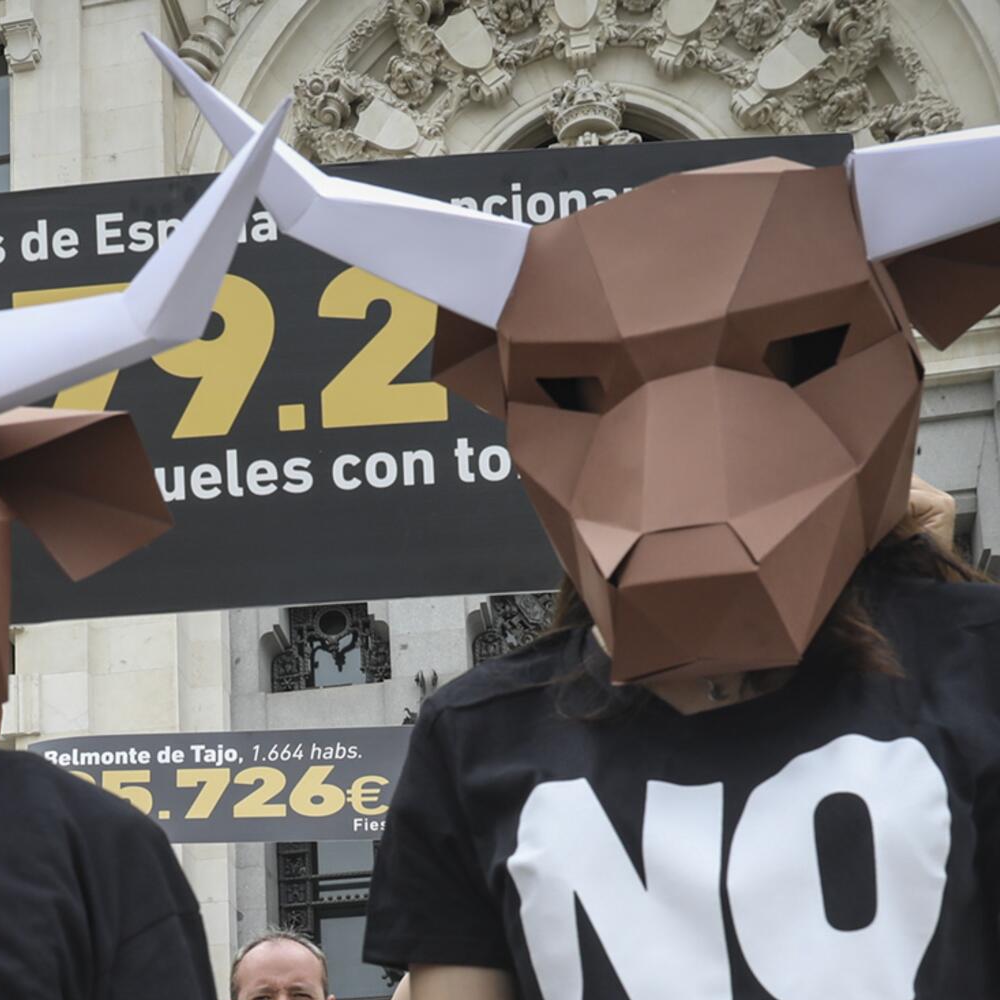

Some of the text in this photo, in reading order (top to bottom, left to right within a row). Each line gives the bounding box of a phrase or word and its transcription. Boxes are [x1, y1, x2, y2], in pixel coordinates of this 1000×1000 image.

[20, 219, 80, 263] de
[154, 437, 523, 502] ueles con to
[44, 742, 363, 767] Belmonte de Tajo, 1.664 habs.
[68, 764, 391, 820] 5.726€
[353, 818, 387, 832] Fies
